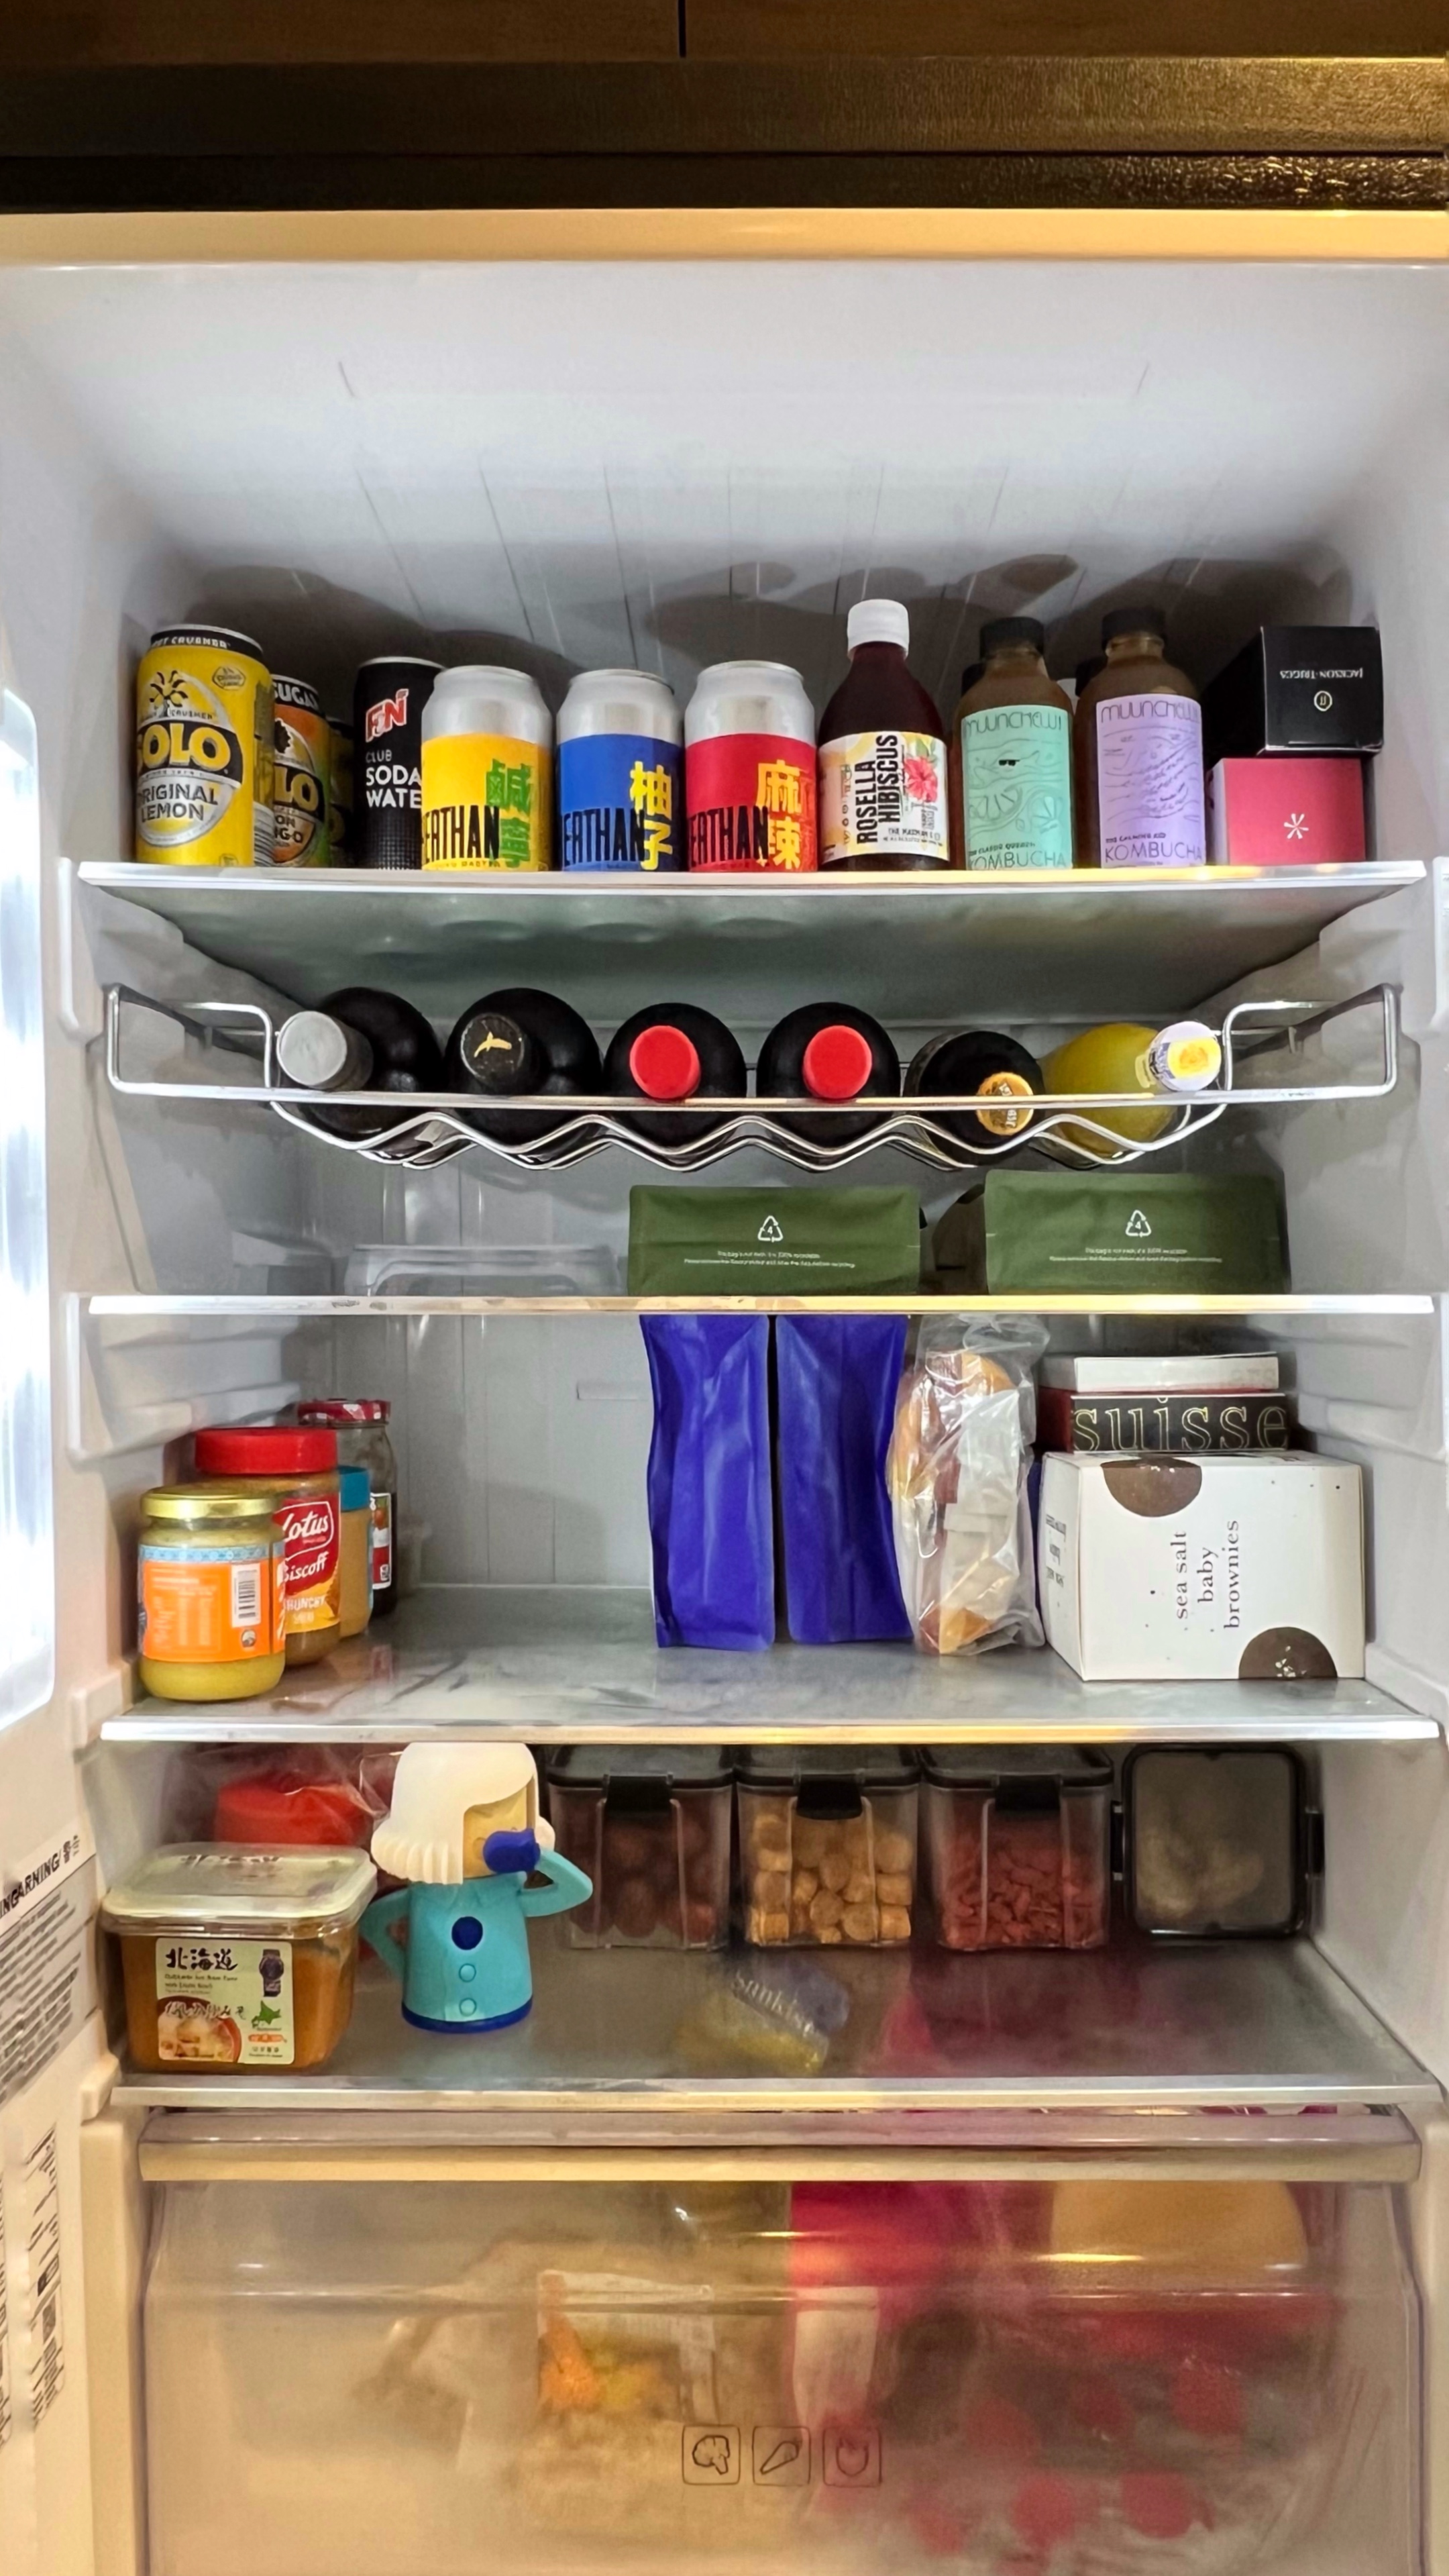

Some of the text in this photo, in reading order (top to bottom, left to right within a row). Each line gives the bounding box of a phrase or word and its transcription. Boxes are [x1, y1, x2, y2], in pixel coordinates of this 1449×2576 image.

[138, 723, 231, 771] OLO
[366, 749, 392, 762] CLUB
[138, 782, 219, 805] RIGINAL
[366, 764, 421, 786] SODA
[366, 788, 422, 809] WATE
[875, 735, 900, 823] HIBISCUS
[142, 803, 204, 823] LEMON
[629, 761, 673, 871] 柚子
[756, 759, 802, 870] 麻辣
[854, 760, 878, 844] ROSELLA
[1105, 841, 1202, 863] KOMBUCHA
[1073, 1396, 1289, 1451] suisse
[282, 1510, 329, 1543] Lotus
[1170, 1531, 1188, 1619] sea salt
[1196, 1547, 1219, 1604] baby
[1222, 1521, 1240, 1629] brownies
[165, 1947, 238, 1971] 北海道
